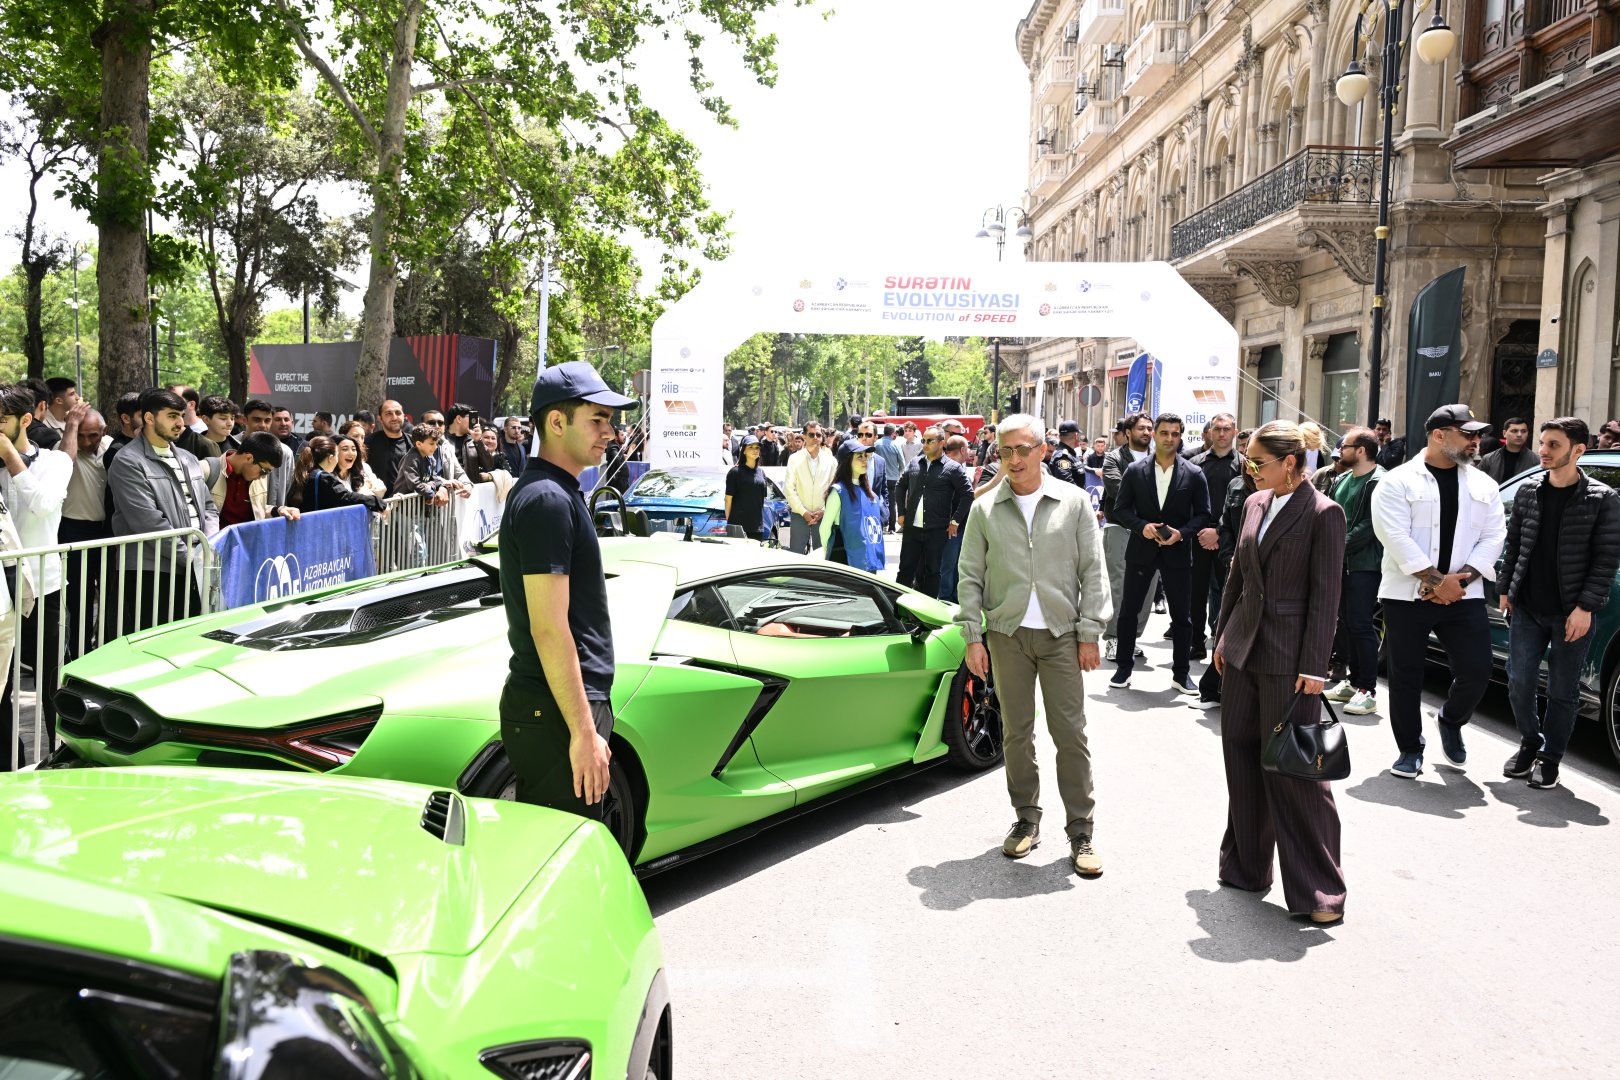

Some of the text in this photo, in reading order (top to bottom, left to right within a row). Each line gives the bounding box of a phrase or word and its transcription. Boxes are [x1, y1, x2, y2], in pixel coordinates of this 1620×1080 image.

[883, 290, 1020, 308] EVOLYUSİYASI
[882, 311, 1017, 323] EVOLUTION of SPEED
[275, 372, 309, 381] EXPECT THE
[385, 376, 415, 386] TEMBER
[274, 383, 312, 392] UNEXPECTED
[663, 430, 697, 438] greencar
